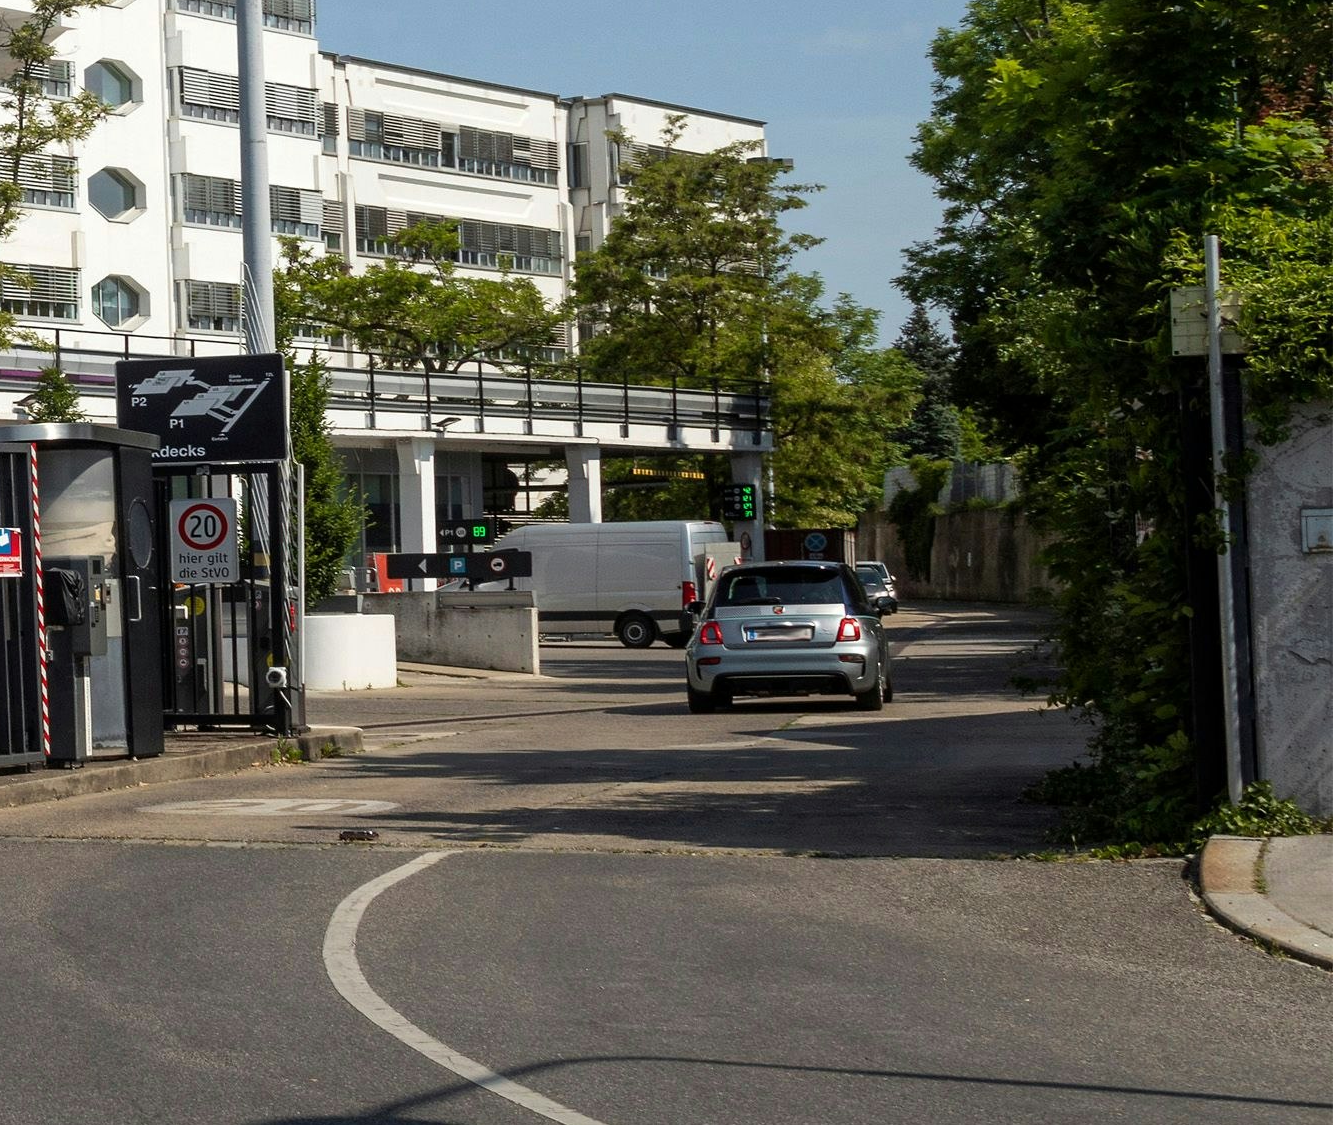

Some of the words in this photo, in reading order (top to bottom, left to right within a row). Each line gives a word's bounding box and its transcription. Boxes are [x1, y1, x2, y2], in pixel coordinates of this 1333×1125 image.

[131, 397, 147, 407] P2
[169, 419, 184, 429] P1
[190, 515, 216, 538] 20
[473, 526, 486, 537] 89
[179, 553, 203, 563] hier
[207, 553, 229, 566] gilt
[179, 567, 198, 578] die
[201, 567, 230, 578] StVO
